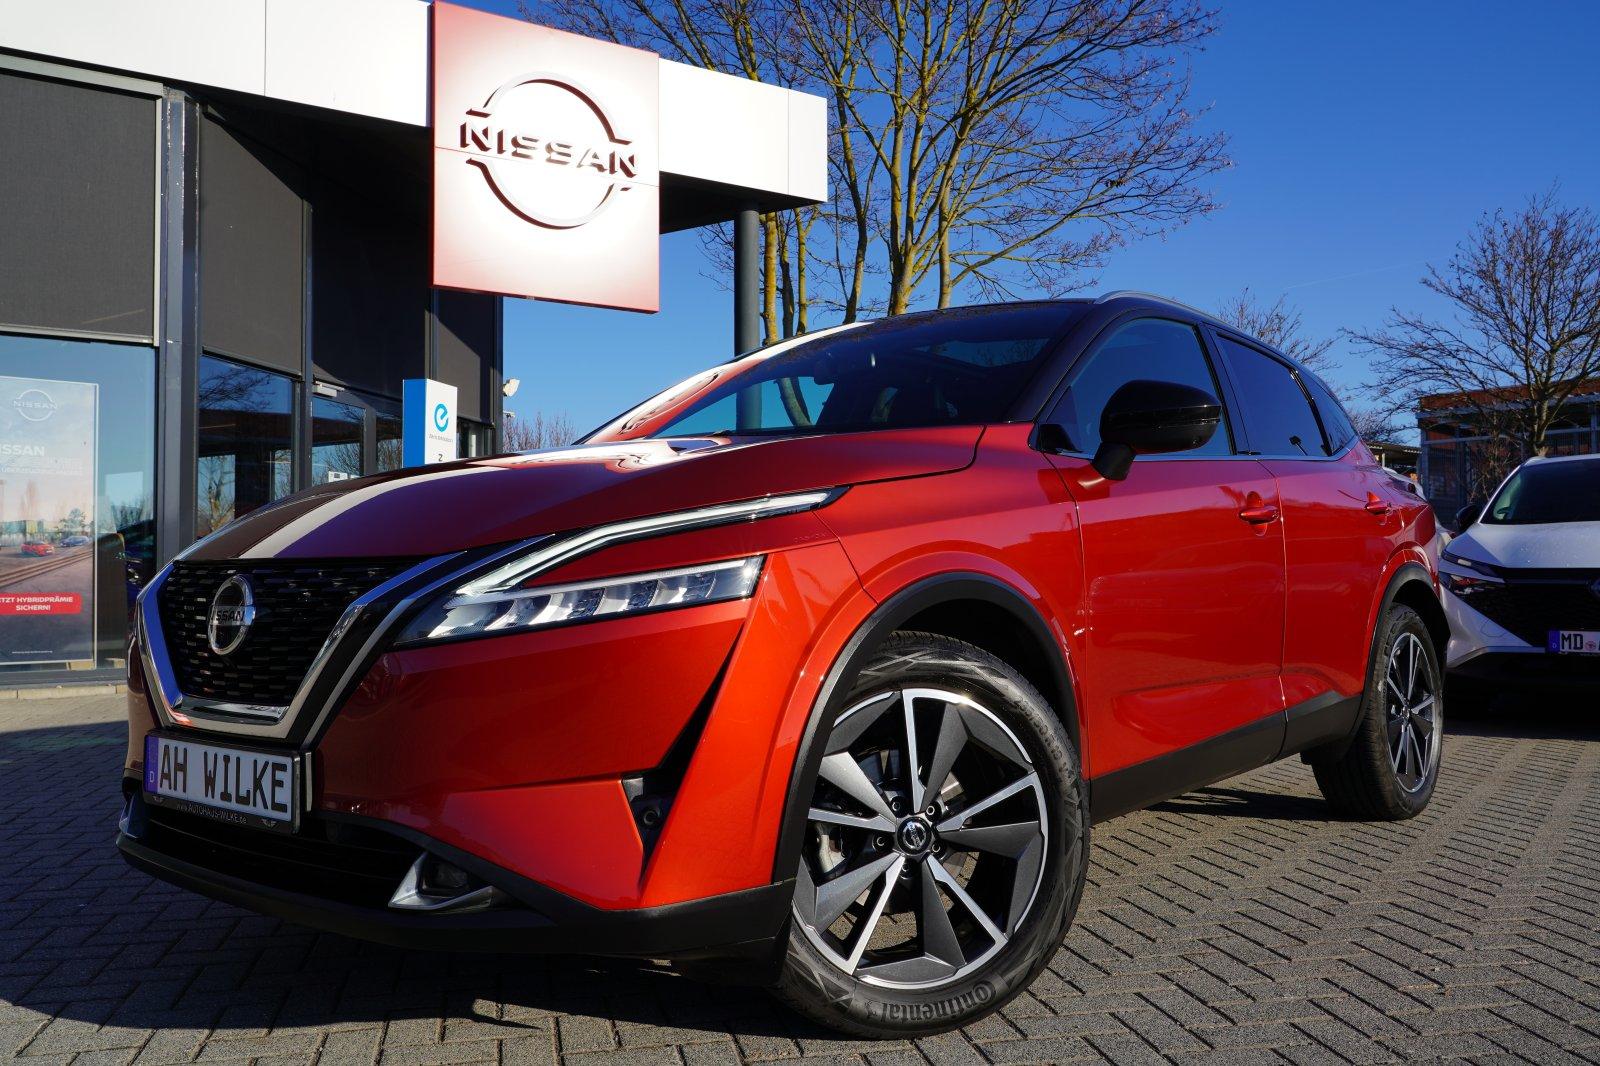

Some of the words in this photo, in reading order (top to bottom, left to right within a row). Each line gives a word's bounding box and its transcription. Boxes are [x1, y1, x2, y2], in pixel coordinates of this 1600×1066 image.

[459, 121, 638, 179] NISSAN
[1561, 633, 1583, 650] MD
[159, 744, 188, 793] AH
[203, 751, 288, 814] WILKE
[882, 980, 997, 1022] Continental
